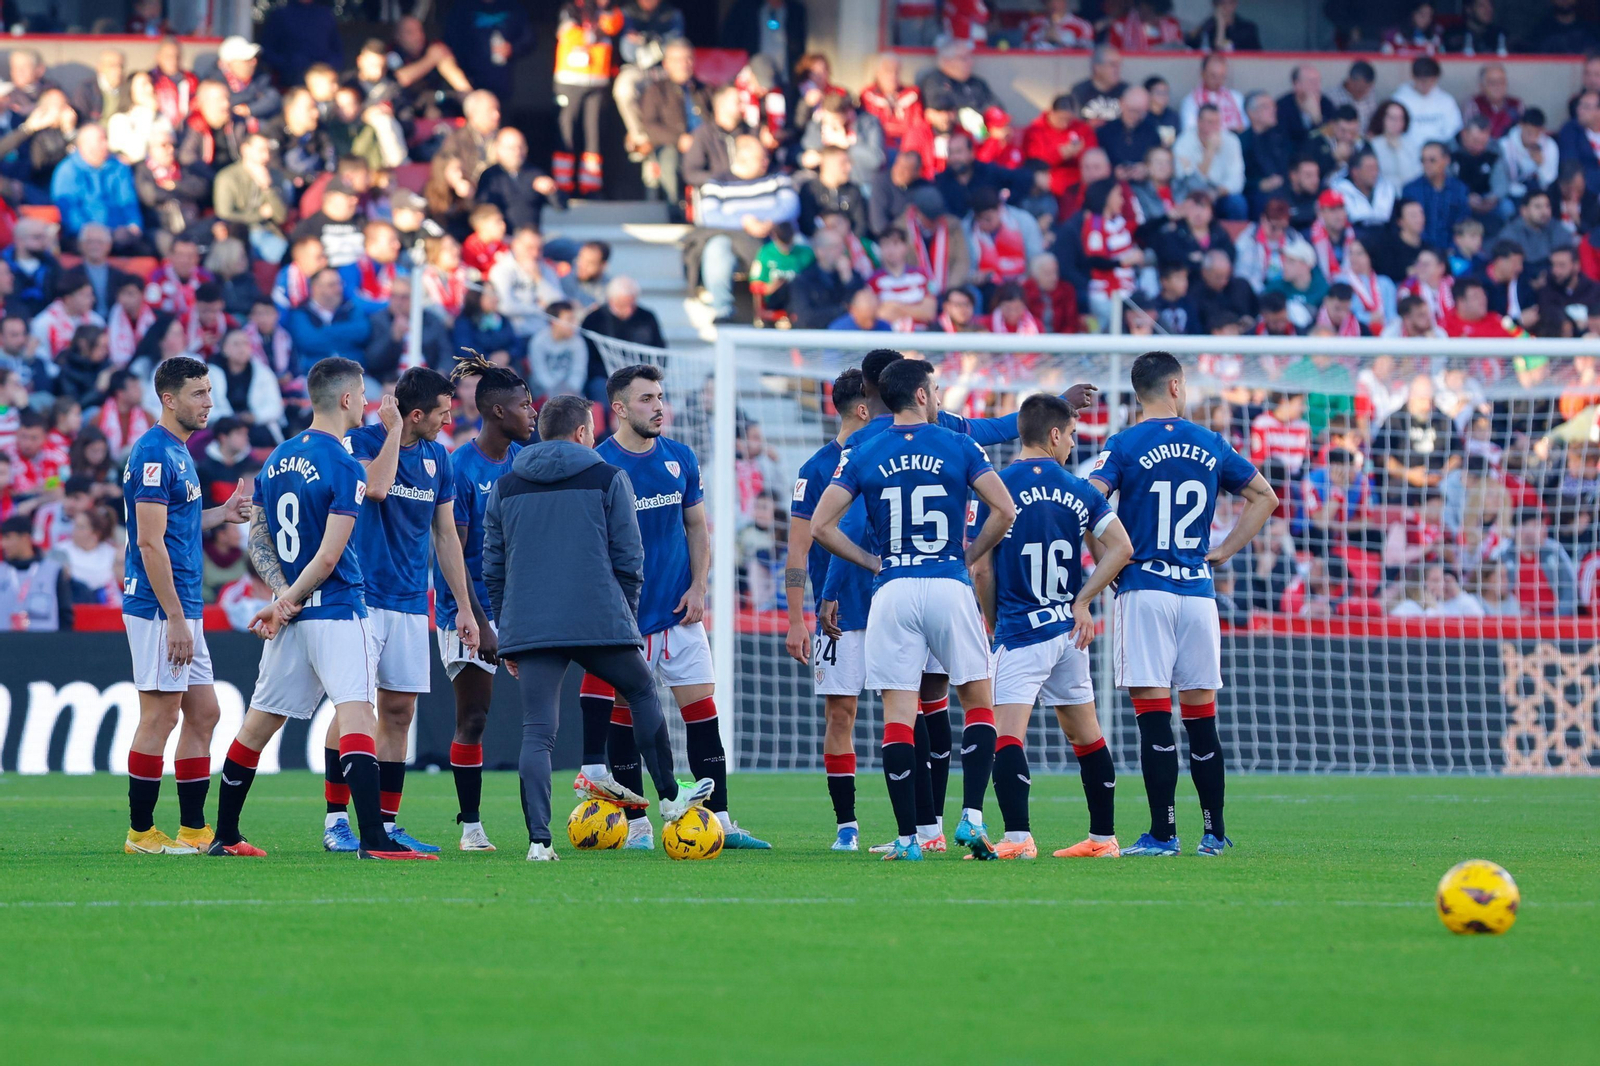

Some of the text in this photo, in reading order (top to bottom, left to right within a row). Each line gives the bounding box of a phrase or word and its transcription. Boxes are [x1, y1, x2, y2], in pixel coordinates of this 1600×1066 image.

[267, 456, 320, 484] O.SANCET
[878, 454, 944, 478] I.LEKUE
[1139, 443, 1217, 471] GURUZETA
[276, 492, 300, 563] 8
[880, 484, 949, 554] 15
[1019, 486, 1090, 537] GALARRETA
[1149, 480, 1208, 550] 12
[1020, 539, 1075, 606] 16
[815, 638, 837, 666] 24
